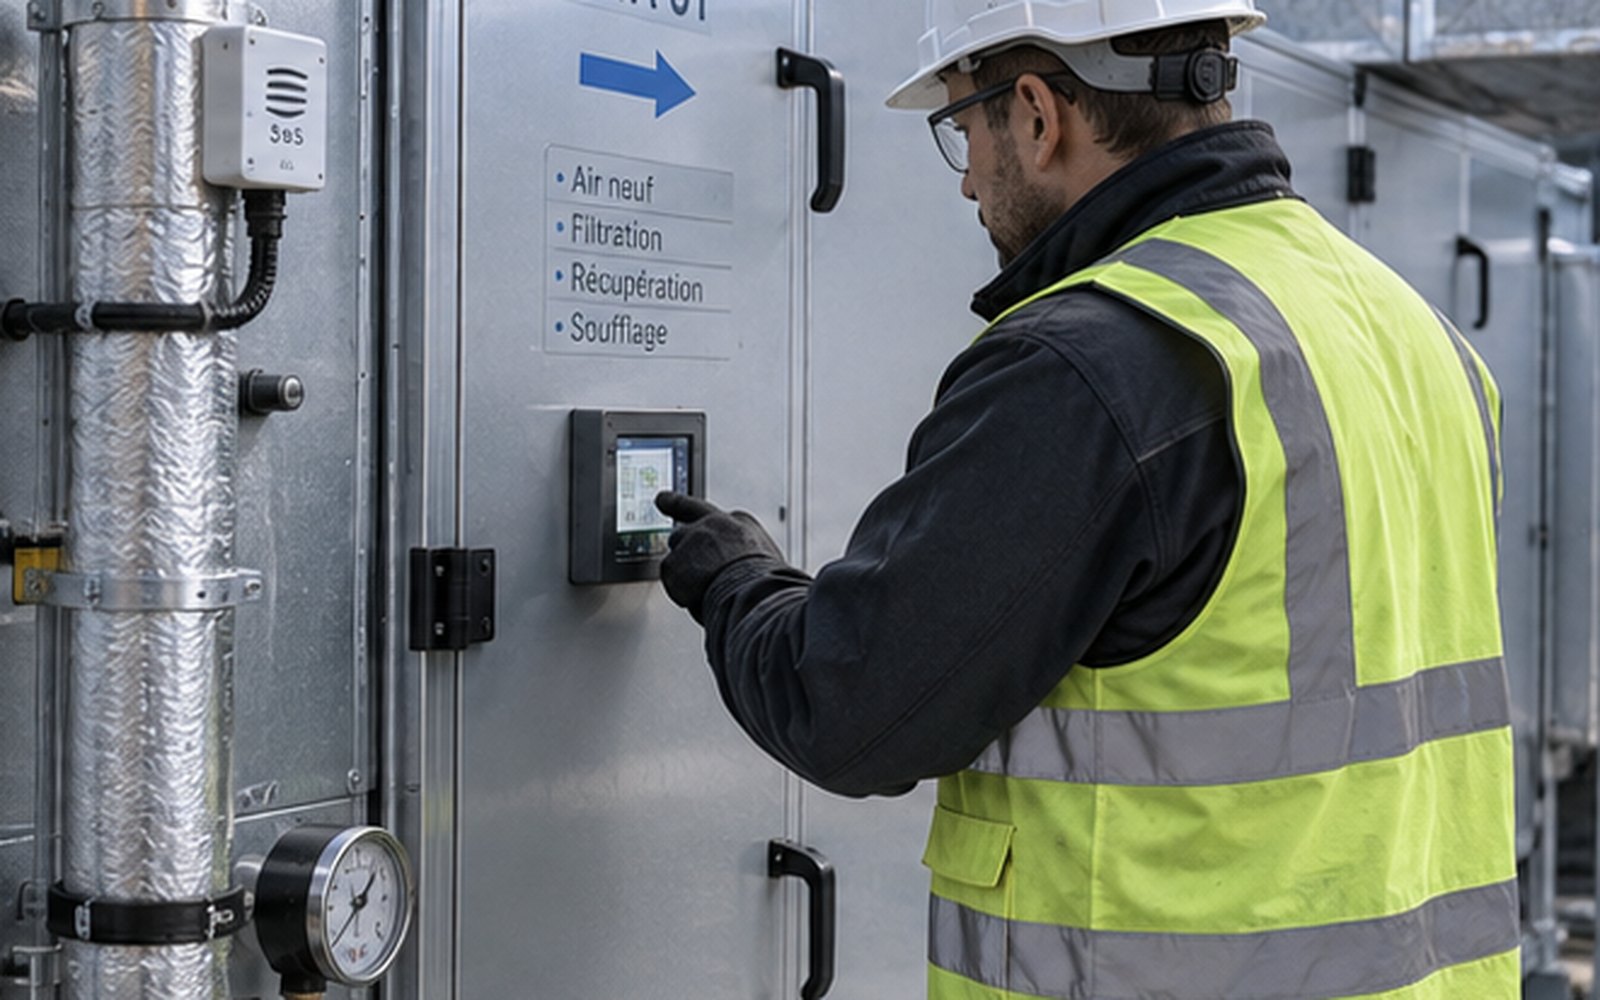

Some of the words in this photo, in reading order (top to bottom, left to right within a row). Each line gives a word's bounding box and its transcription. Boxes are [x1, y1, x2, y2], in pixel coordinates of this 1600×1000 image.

[571, 165, 602, 196] Air
[608, 176, 653, 203] neuf
[571, 213, 662, 251] Filtration
[571, 262, 703, 302] Récupération
[570, 311, 667, 352] Soufflage
